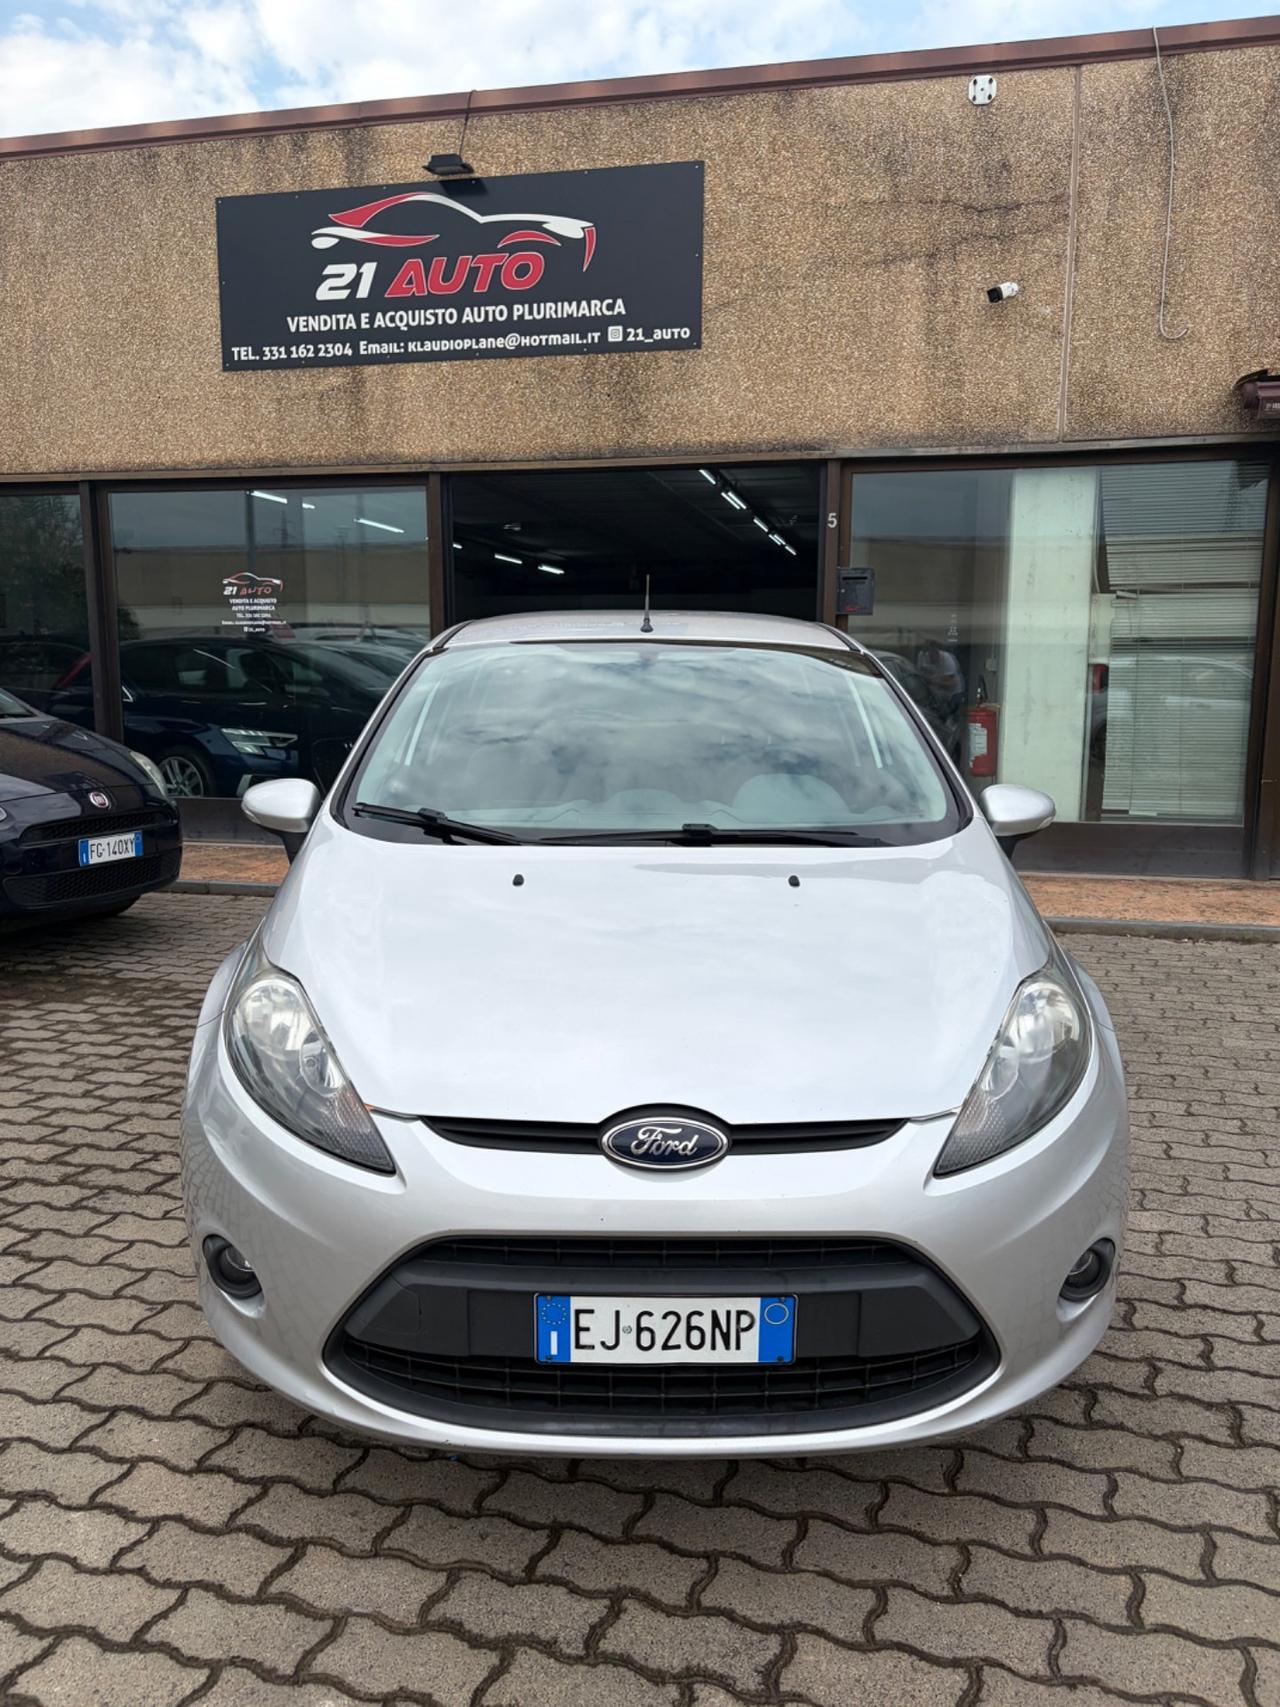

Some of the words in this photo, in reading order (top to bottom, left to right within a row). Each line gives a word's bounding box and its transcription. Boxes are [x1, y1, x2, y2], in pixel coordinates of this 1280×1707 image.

[315, 261, 378, 301] 21
[384, 251, 545, 298] AUTO
[286, 313, 357, 333] VENDITA
[360, 312, 370, 329] E
[373, 307, 458, 331] ACQUISTO
[461, 305, 508, 324] AUTO
[512, 298, 626, 321] PLURIMARCA
[231, 346, 260, 361] TEL.
[262, 345, 287, 360] 331
[290, 344, 314, 359] 162
[317, 342, 353, 358] 2304
[827, 512, 838, 529] 5
[223, 586, 238, 596] 21
[239, 586, 273, 596] AUTO
[630, 1126, 699, 1156] Ford
[573, 1308, 757, 1352] EJ626NP
